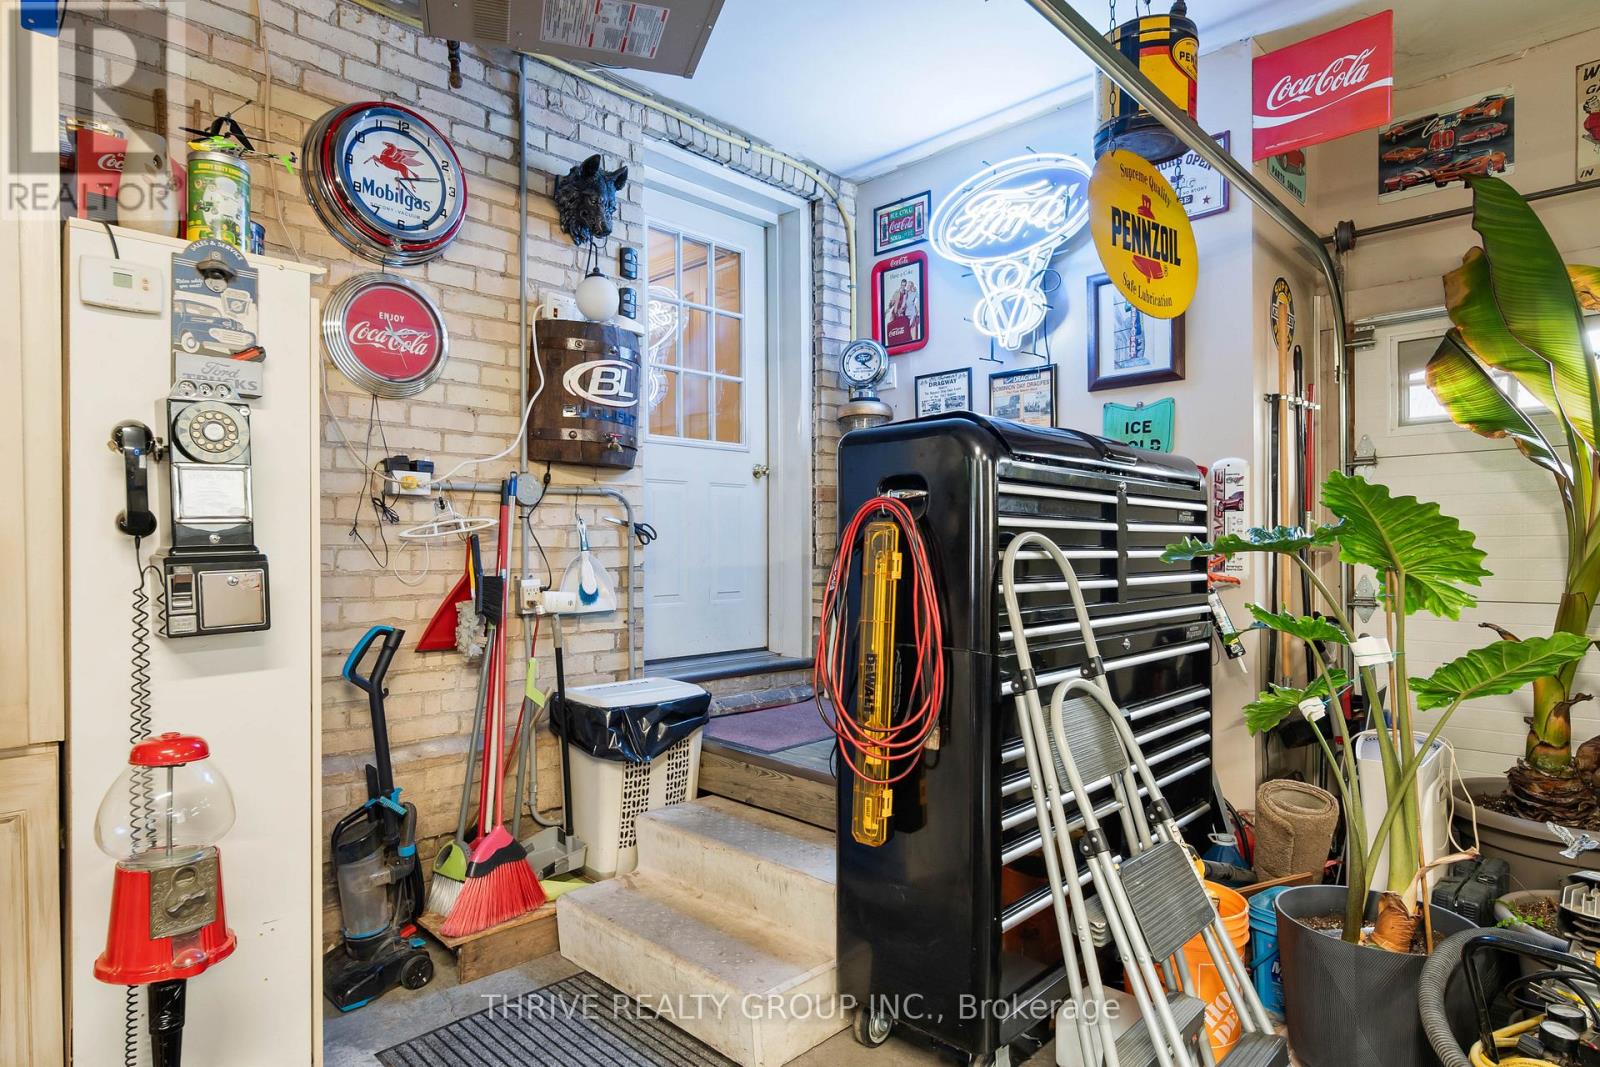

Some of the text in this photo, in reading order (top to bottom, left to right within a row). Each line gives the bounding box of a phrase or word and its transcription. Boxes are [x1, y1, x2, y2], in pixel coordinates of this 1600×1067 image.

[1266, 46, 1376, 111] Coca-Cola
[375, 119, 383, 131] 11
[399, 119, 410, 135] 12
[355, 130, 366, 144] 10
[345, 153, 354, 165] 9
[441, 160, 450, 172] 2
[1580, 168, 1594, 178] IN
[353, 181, 362, 193] 8
[1119, 163, 1171, 208] Supreme Quality
[361, 176, 431, 212] Mobilgas
[448, 186, 456, 198] 3
[371, 204, 380, 216] 7
[439, 208, 448, 219] 4
[397, 219, 406, 231] 6
[422, 219, 430, 231] 5
[1110, 206, 1181, 267] PENNZOIL
[1122, 272, 1173, 307] Safe Lubrication
[378, 312, 405, 323] ENJOY
[201, 361, 240, 379] Ford
[1125, 420, 1152, 434] ICE
